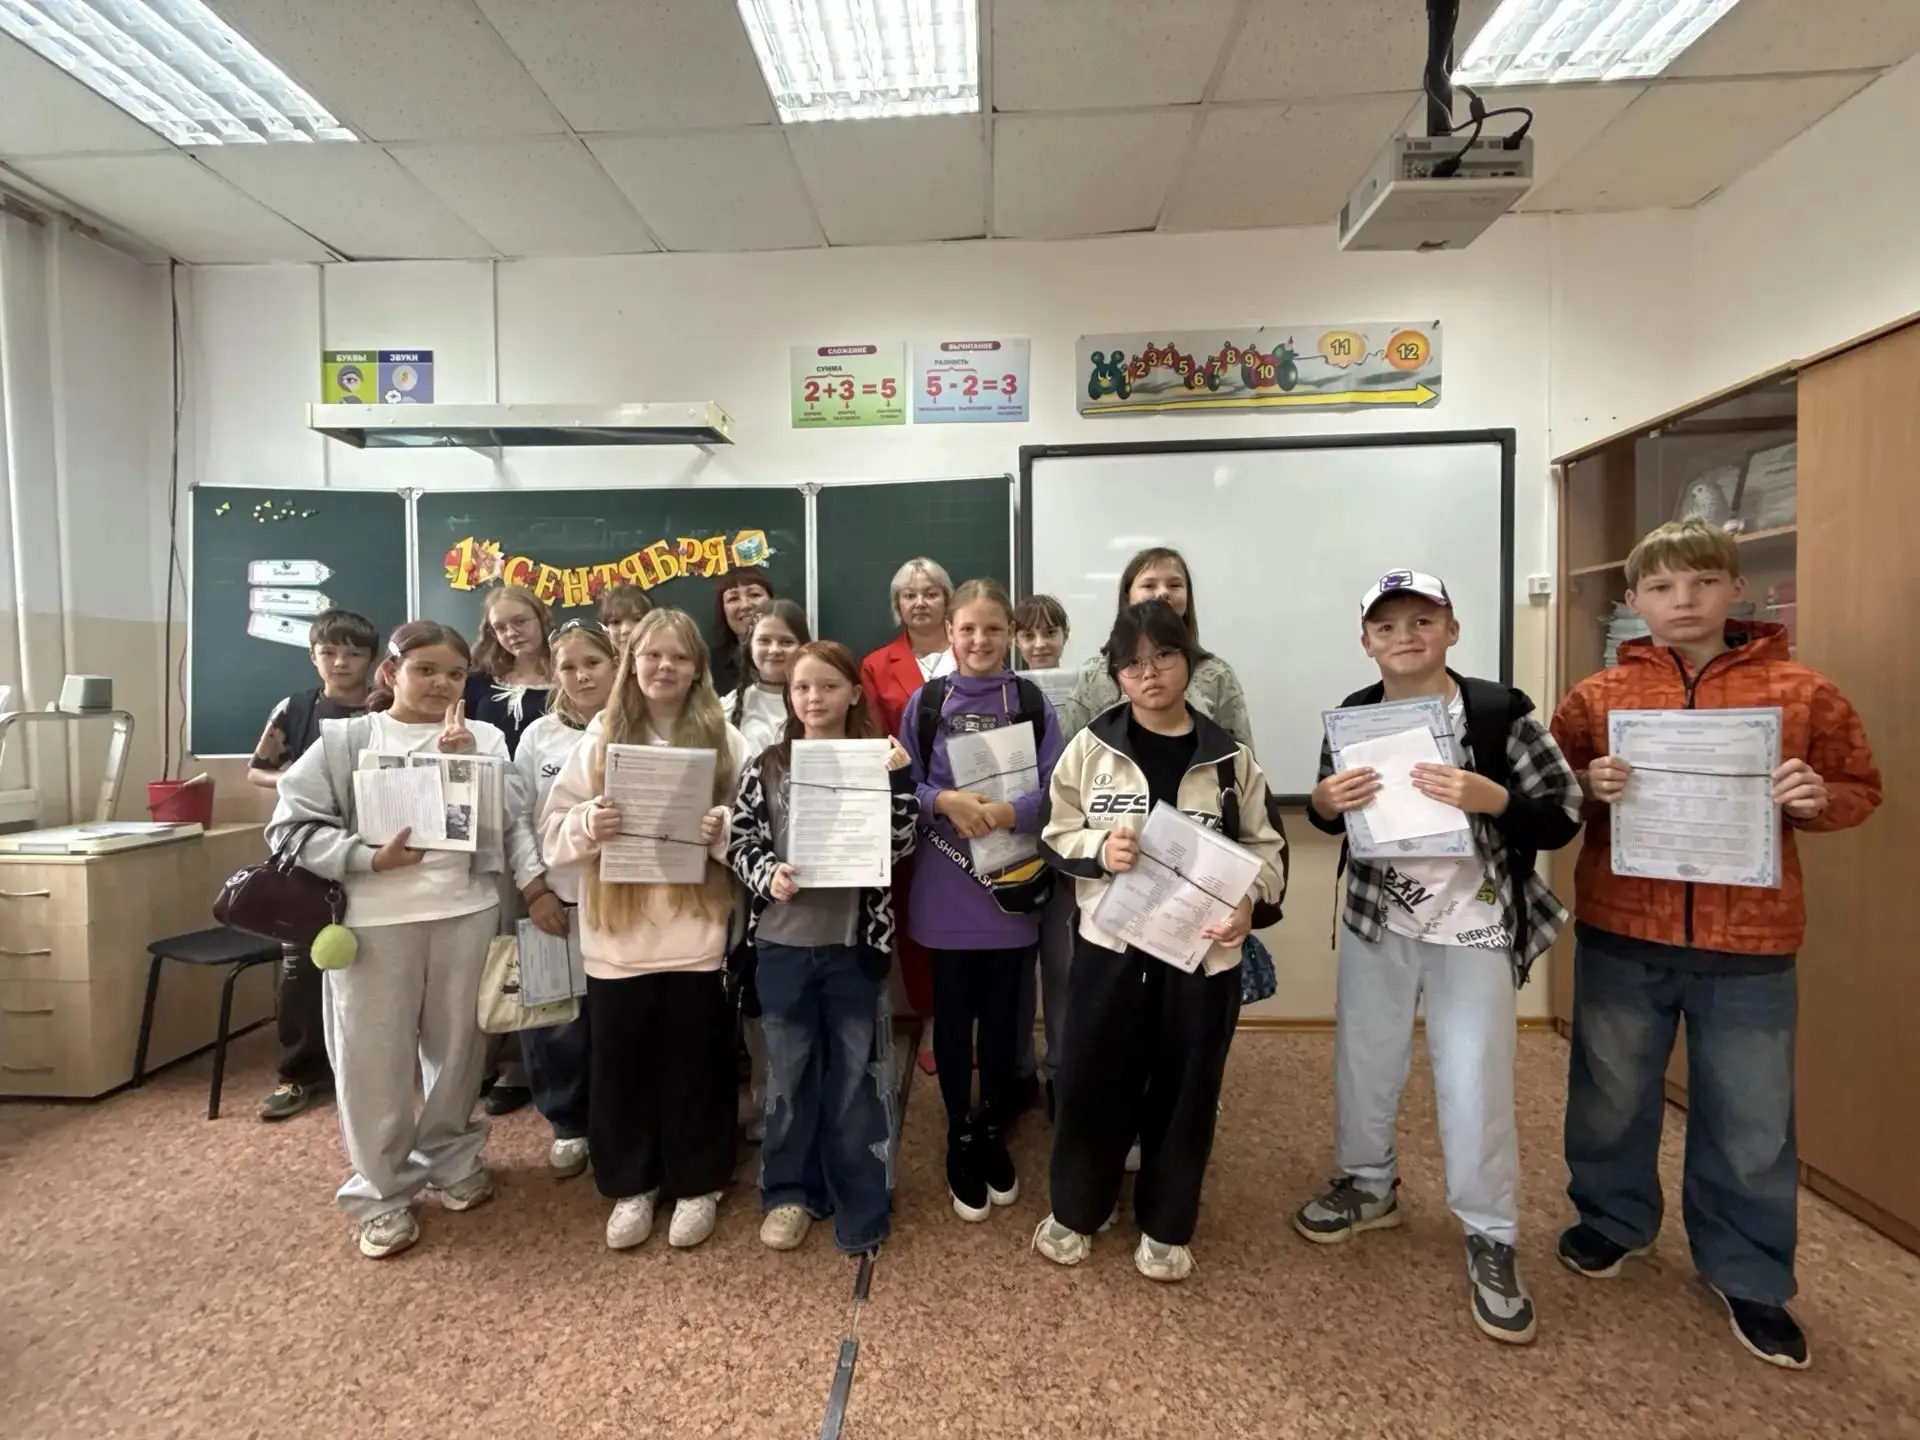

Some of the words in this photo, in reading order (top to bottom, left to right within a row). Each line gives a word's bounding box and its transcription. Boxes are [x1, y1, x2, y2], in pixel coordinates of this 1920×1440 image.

[827, 346, 867, 355] СЛОЖЕНИЕ
[948, 342, 993, 350] ВЫЧИТАНИЕ
[336, 353, 367, 362] БУКВЫ
[389, 353, 419, 362] ЗВУКИ
[934, 358, 969, 366] РАЗНОСТЬ
[1136, 361, 1146, 376] 2
[1148, 352, 1158, 366] 3
[1162, 352, 1173, 366] 4
[1179, 360, 1189, 374] 5
[1193, 372, 1204, 386] 6
[1211, 361, 1221, 375] 7
[1226, 350, 1236, 364] 8
[1244, 353, 1254, 368] 9
[1257, 364, 1275, 379] 10
[1330, 338, 1351, 356] 11
[1397, 343, 1419, 360] 12
[451, 536, 475, 591] 1
[503, 536, 729, 608] СЕНТЯБРЯ
[927, 830, 970, 869] FASHION
